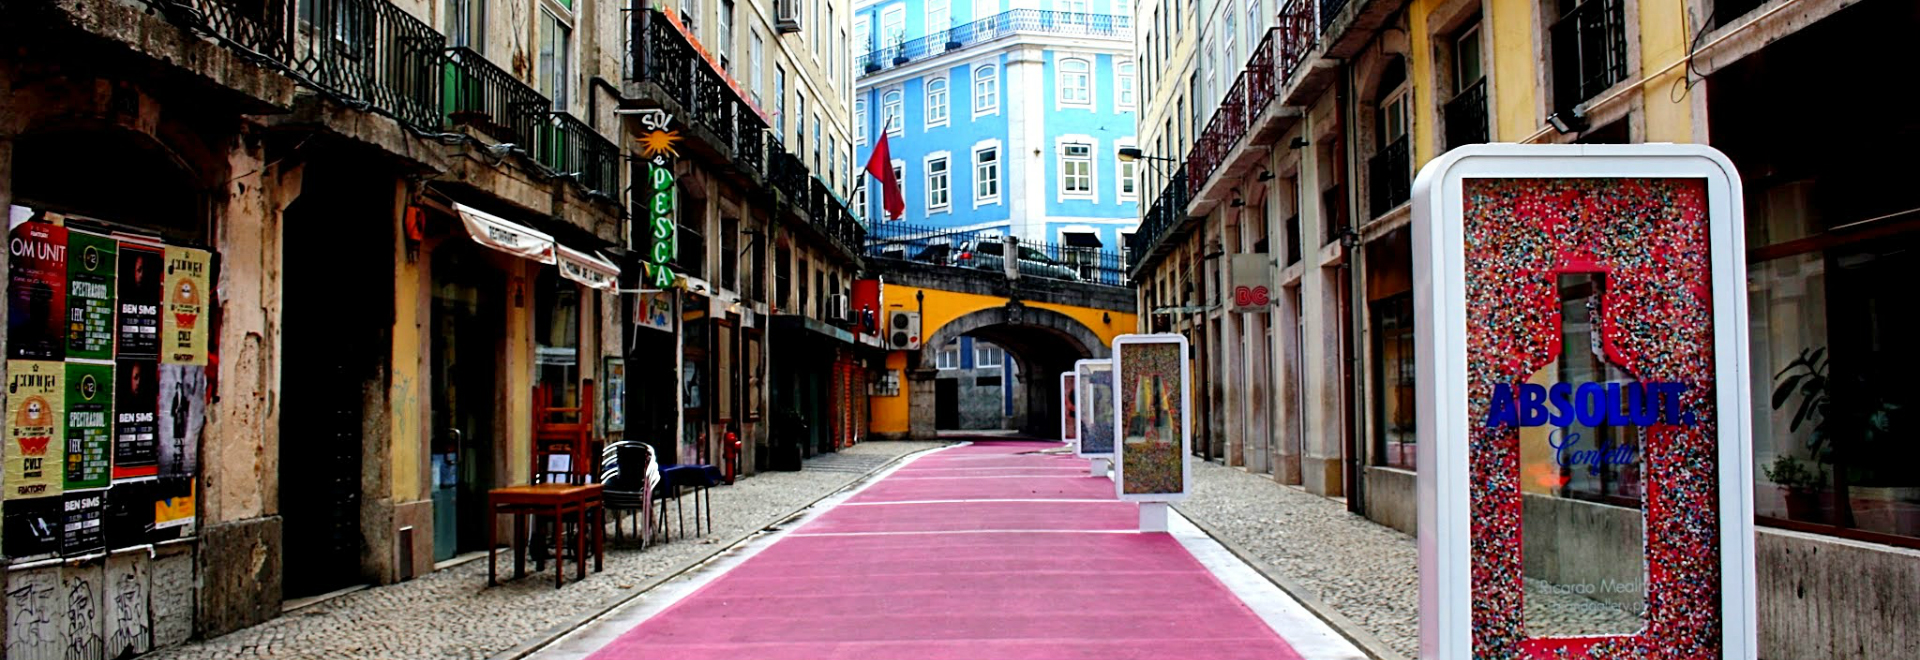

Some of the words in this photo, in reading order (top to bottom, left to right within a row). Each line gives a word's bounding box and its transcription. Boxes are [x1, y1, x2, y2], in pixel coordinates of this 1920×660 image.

[641, 111, 674, 132] SOL
[653, 167, 669, 287] PESCA
[10, 237, 35, 259] OM
[37, 241, 66, 263] UNIT
[1235, 285, 1270, 307] BC
[122, 303, 137, 314] BEN
[138, 304, 157, 315] SIMS
[119, 413, 134, 423] BEN
[135, 412, 154, 423] SIMS
[1549, 428, 1636, 476] Confetti
[64, 500, 81, 512] BEN
[81, 496, 100, 509] SIMS
